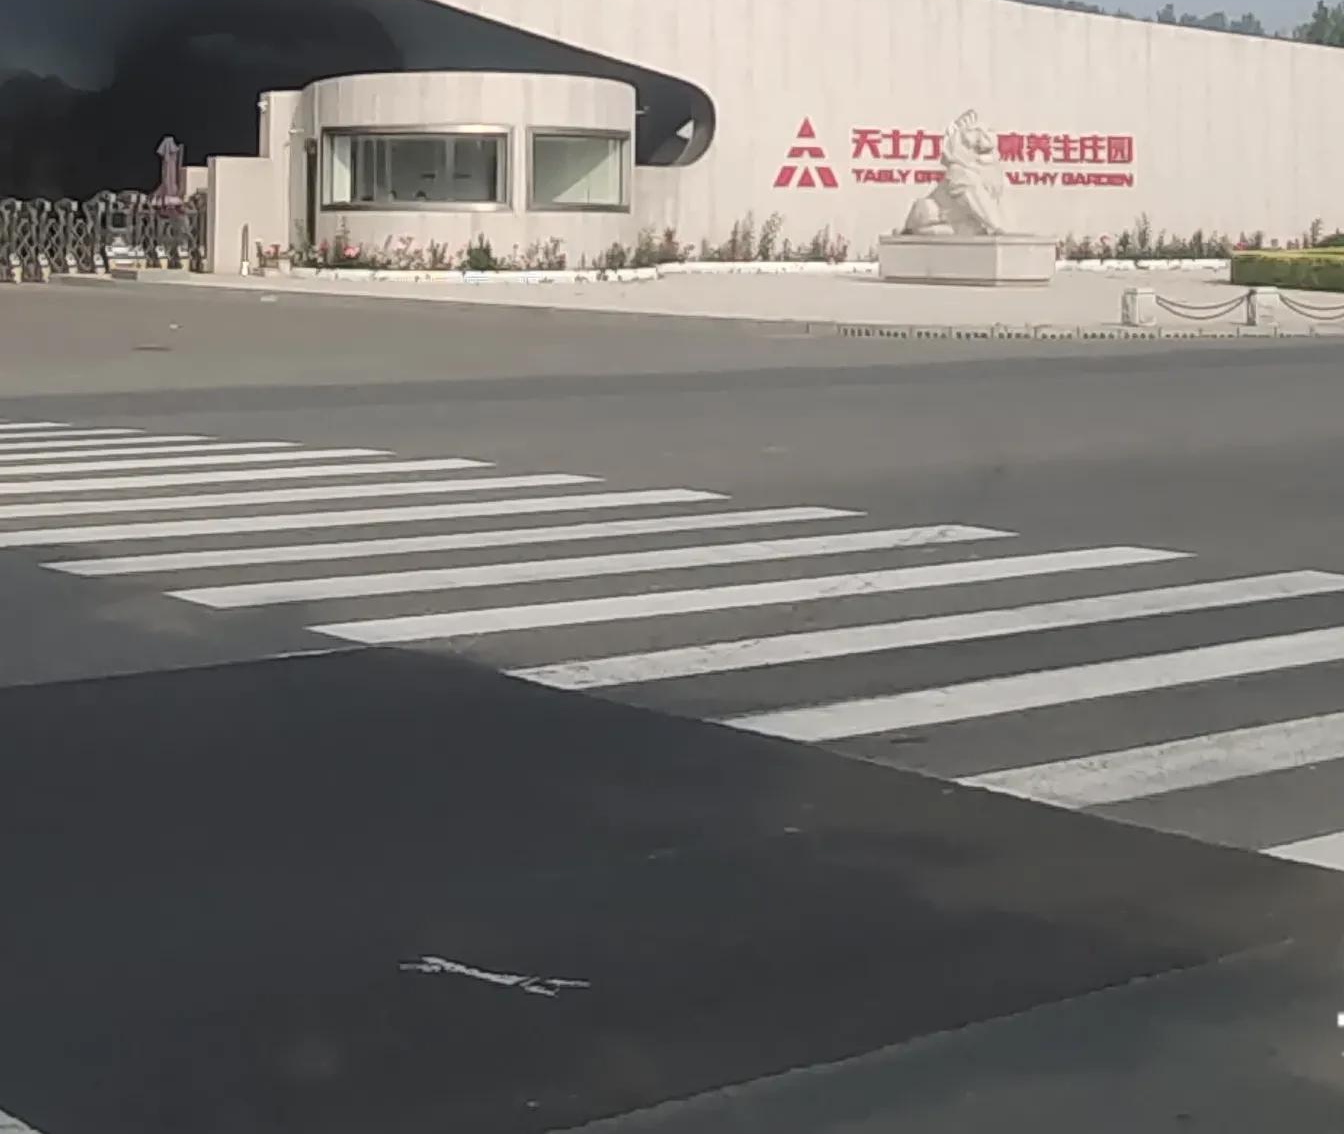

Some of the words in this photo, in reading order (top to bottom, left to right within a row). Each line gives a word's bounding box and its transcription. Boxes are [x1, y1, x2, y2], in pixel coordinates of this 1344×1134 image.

[851, 128, 1134, 164] 天士力康养生庄园
